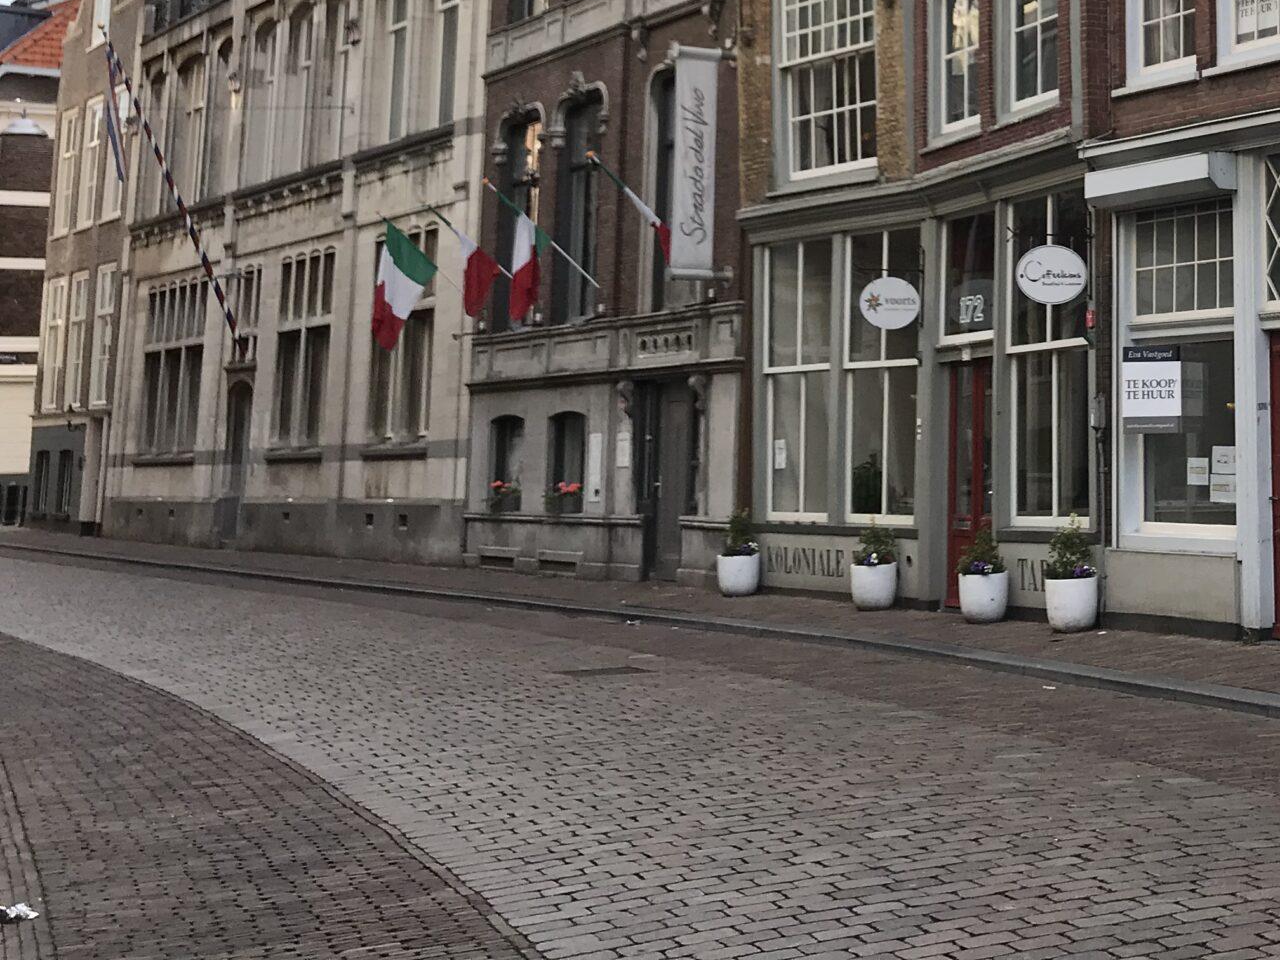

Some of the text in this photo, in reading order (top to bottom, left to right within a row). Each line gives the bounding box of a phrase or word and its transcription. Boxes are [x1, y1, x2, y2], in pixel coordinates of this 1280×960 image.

[959, 294, 985, 324] 172
[1125, 379, 1140, 389] TE
[1125, 389, 1176, 400] TE HUUR
[767, 546, 845, 578] KOLONIALE
